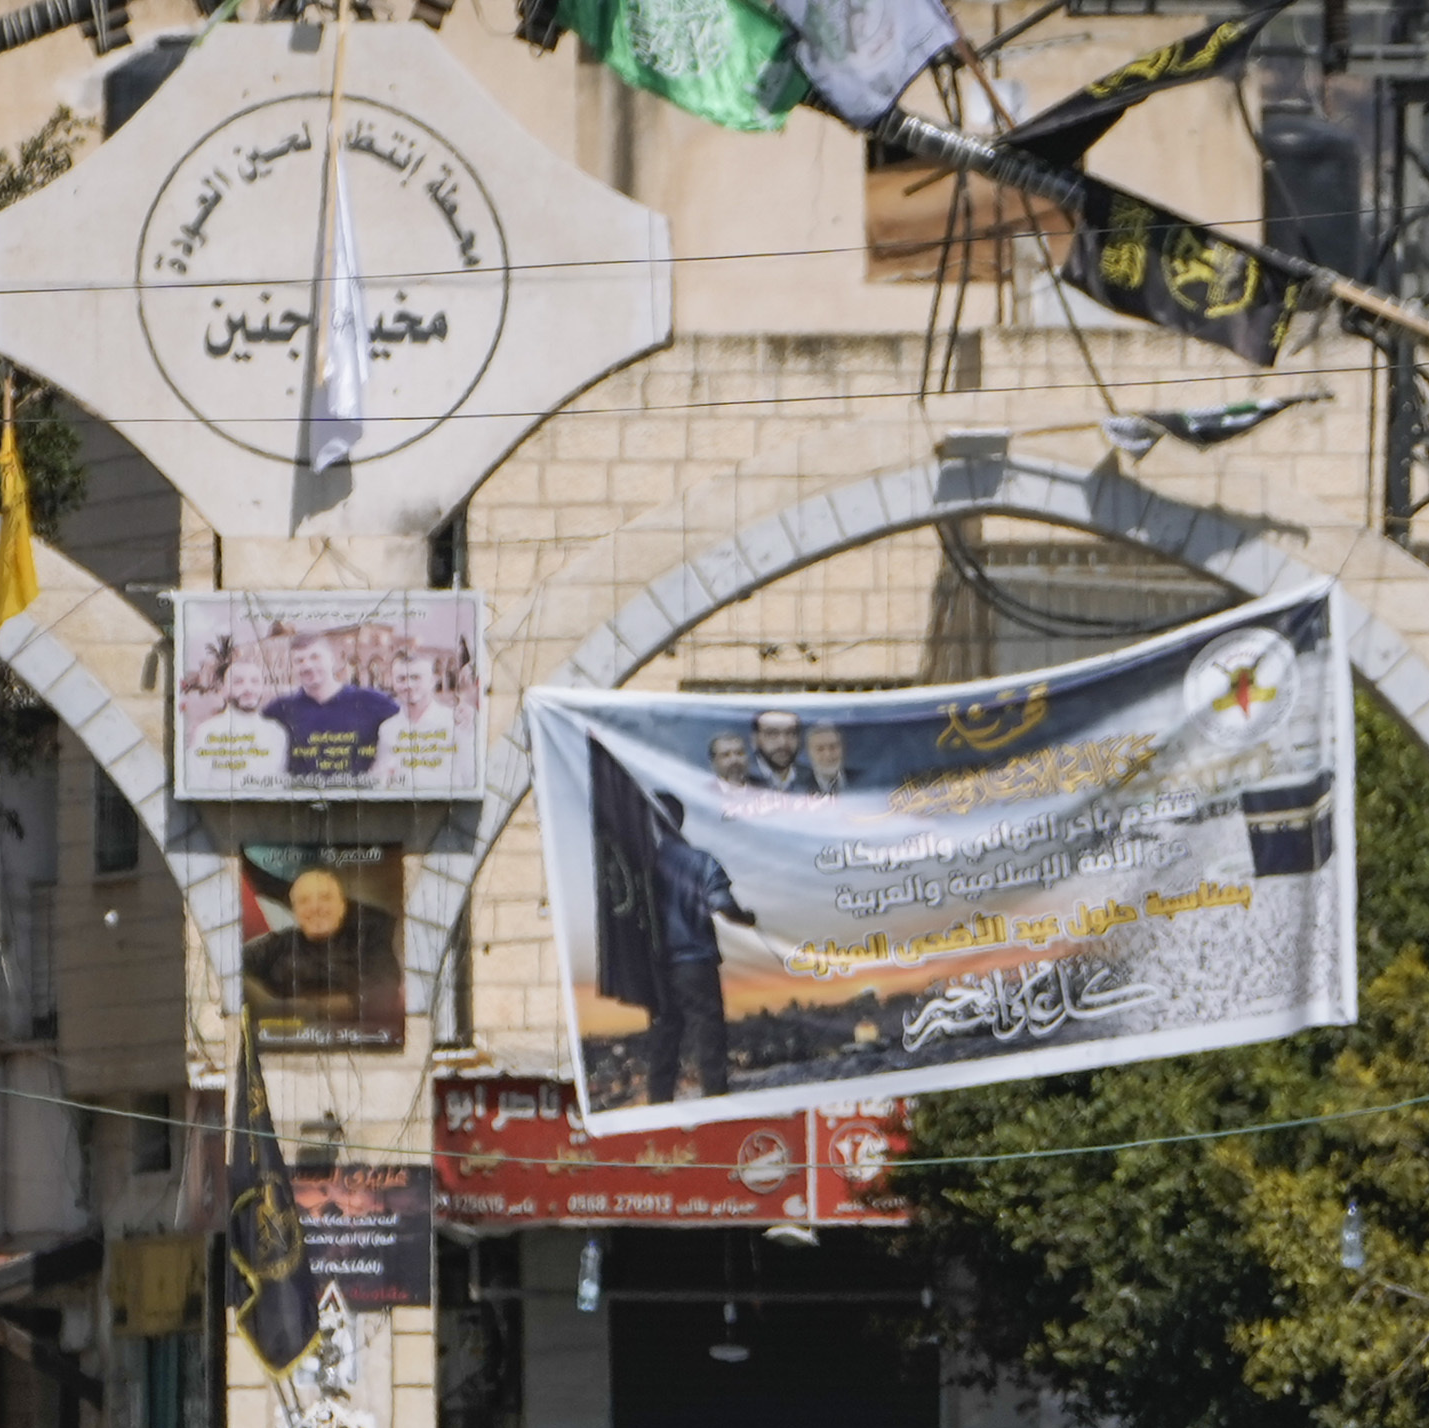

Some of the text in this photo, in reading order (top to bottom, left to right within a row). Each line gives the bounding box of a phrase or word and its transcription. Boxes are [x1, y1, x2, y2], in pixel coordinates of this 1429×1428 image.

[154, 119, 480, 275] محطة إنتظا لحين العودة
[204, 290, 448, 361] مخي جنين
[1143, 881, 1252, 921] بمناسبة
[786, 930, 889, 976] المبارك
[1011, 912, 1060, 949] عيد
